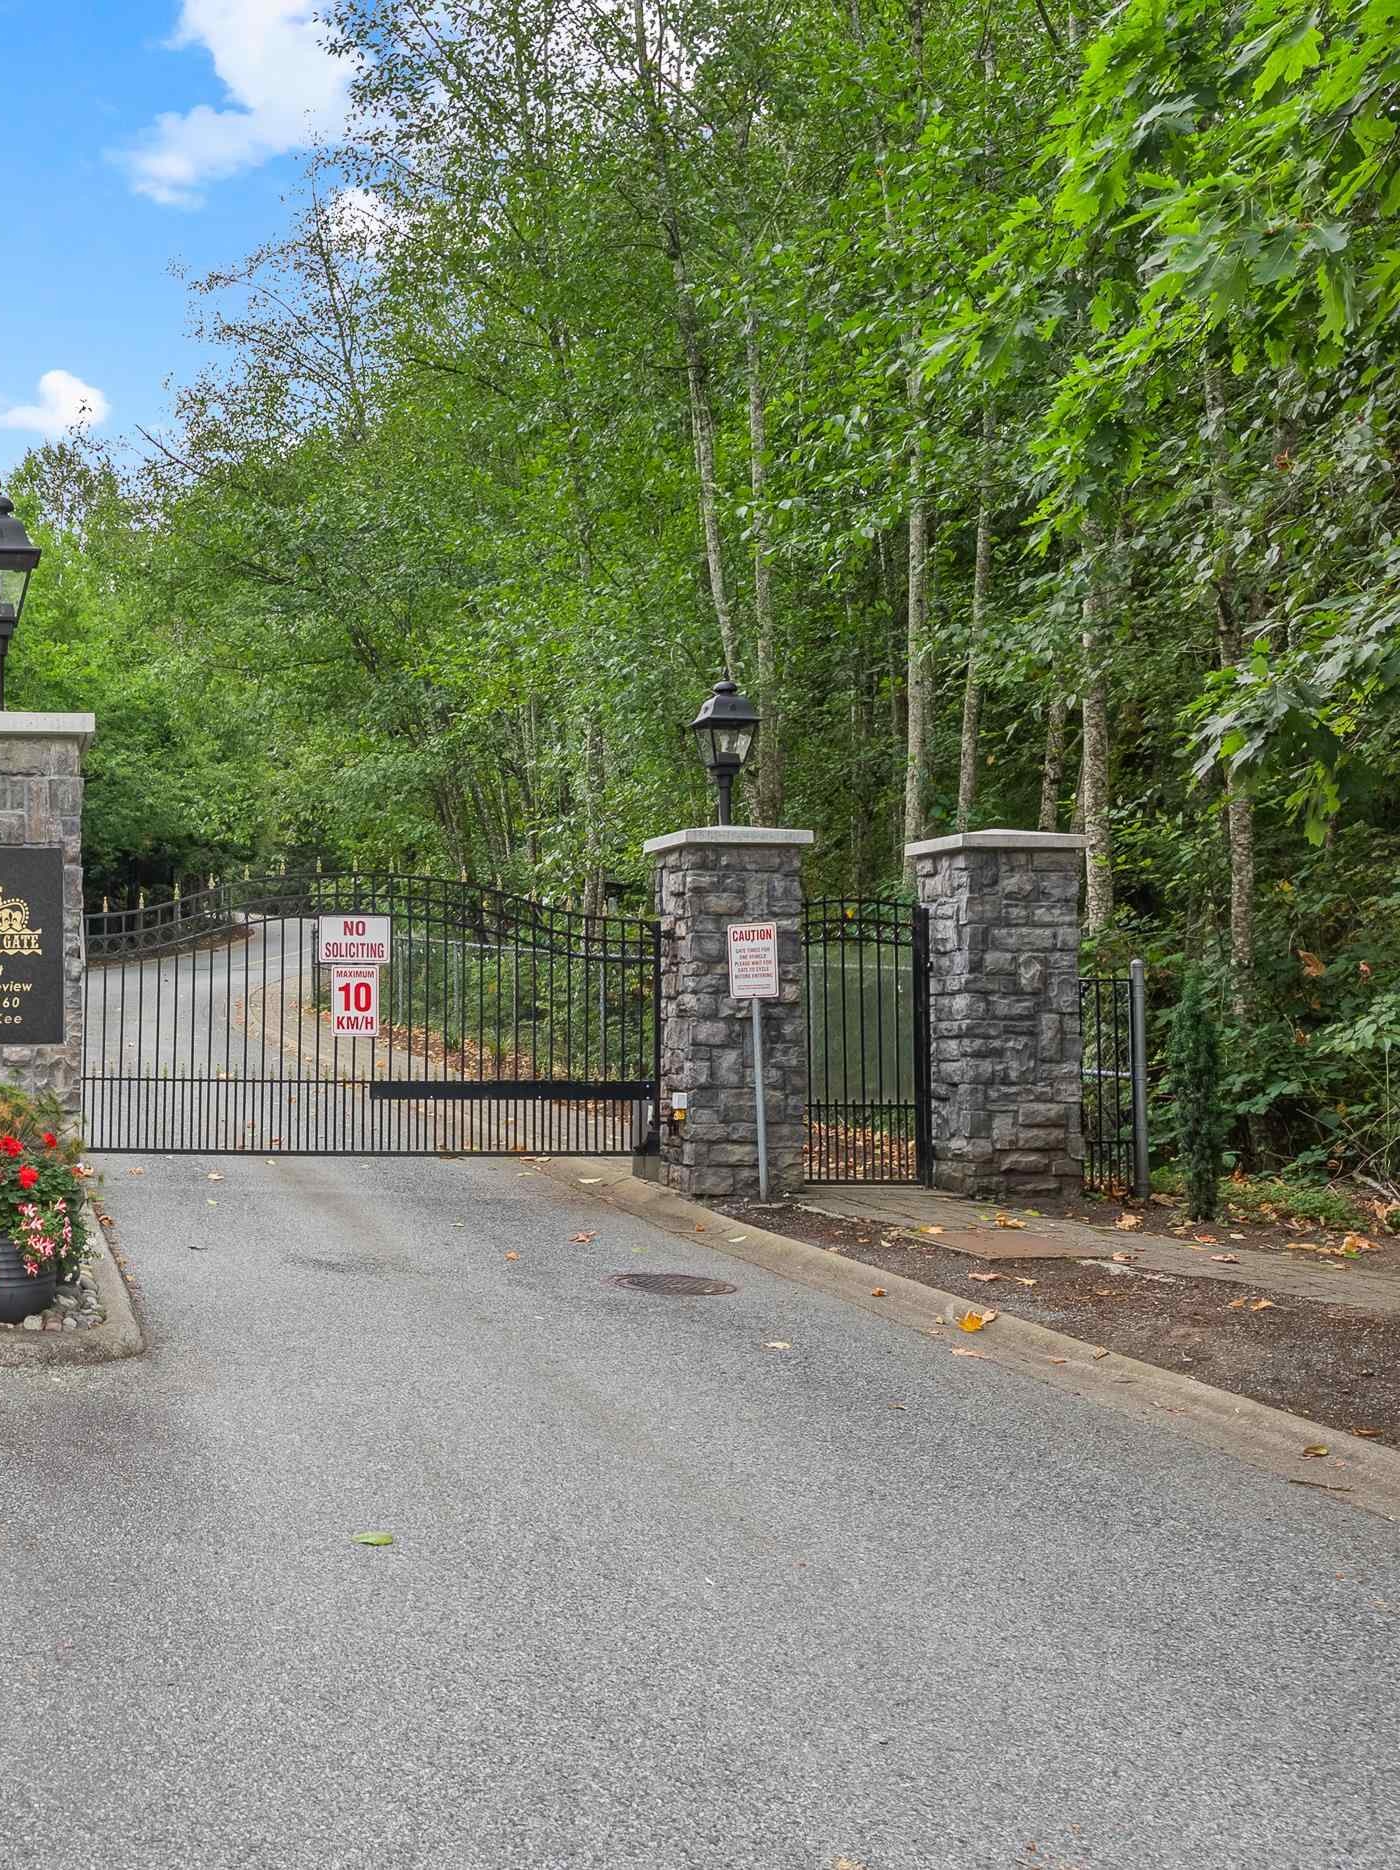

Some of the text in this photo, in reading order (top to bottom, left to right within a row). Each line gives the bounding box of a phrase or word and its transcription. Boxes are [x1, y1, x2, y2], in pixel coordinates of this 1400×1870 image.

[343, 920, 366, 936] NO
[732, 928, 772, 942] CAUTION
[3, 934, 39, 949] GATE
[325, 942, 385, 958] SOLICITING
[336, 970, 375, 978] MAXIMUM
[338, 982, 372, 1012] 10
[336, 1016, 374, 1030] KM/H
